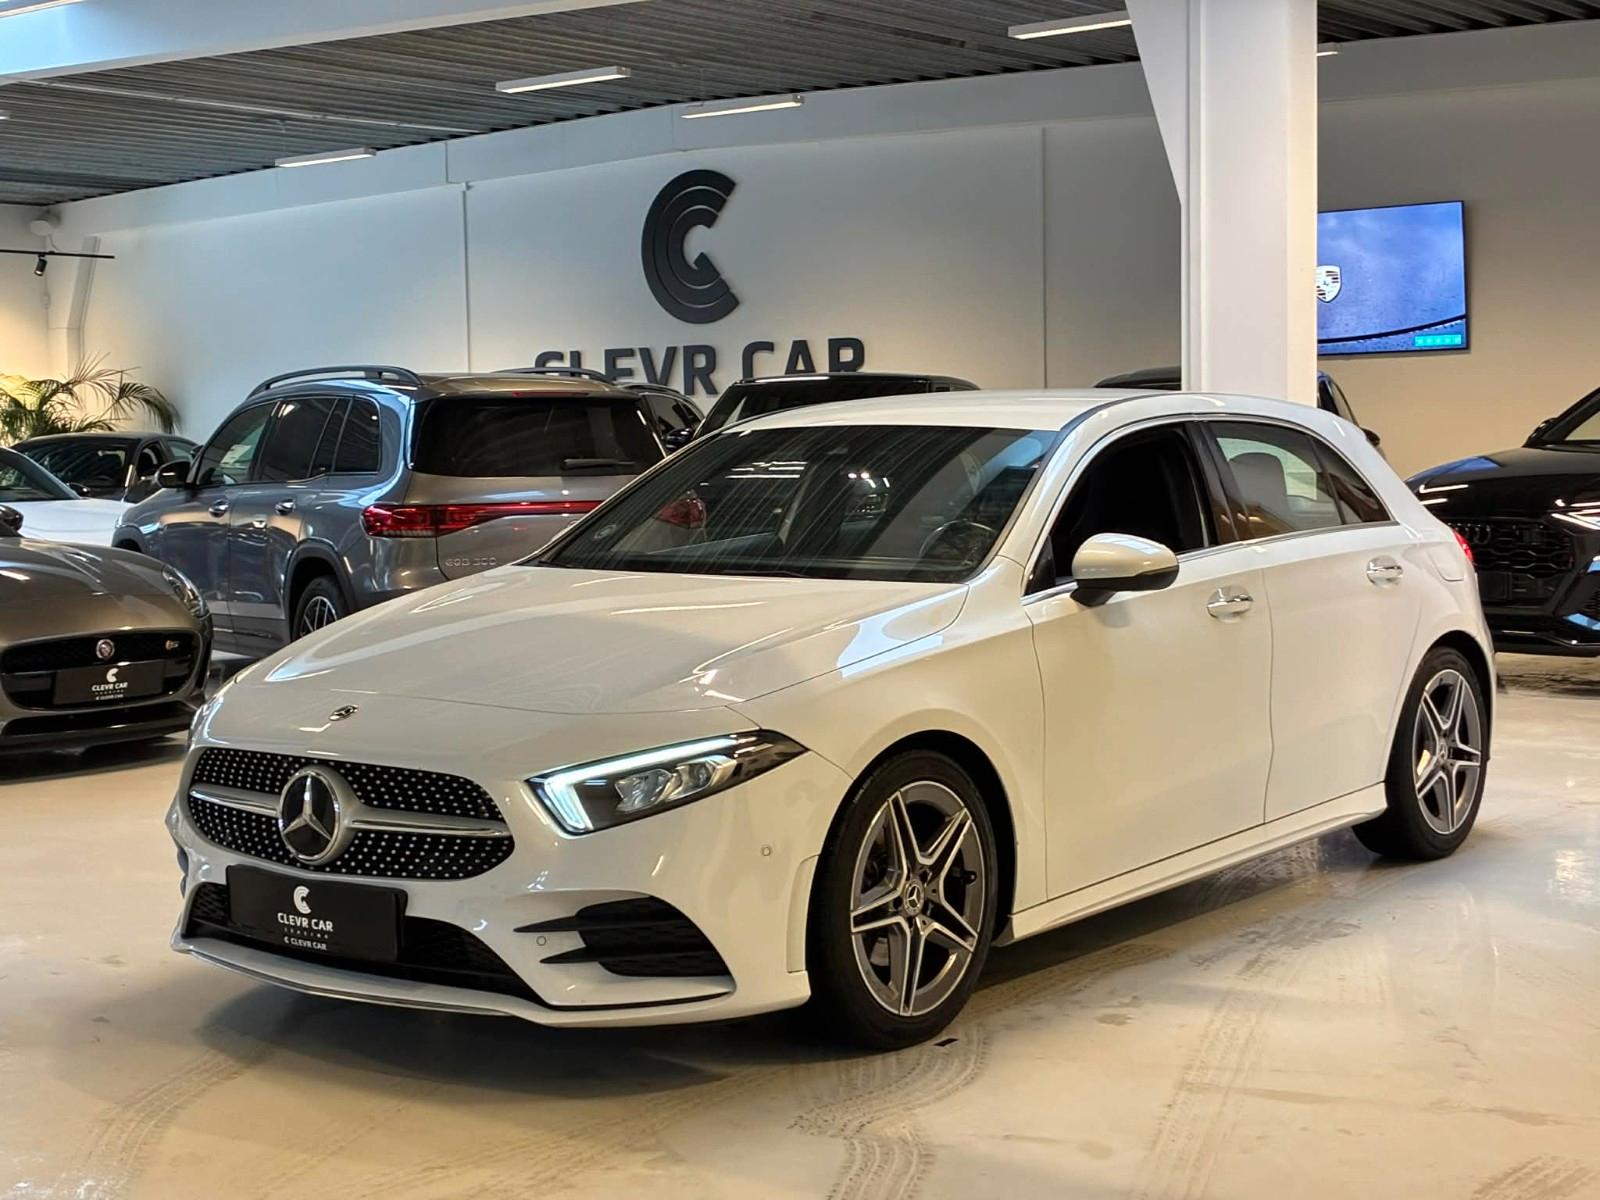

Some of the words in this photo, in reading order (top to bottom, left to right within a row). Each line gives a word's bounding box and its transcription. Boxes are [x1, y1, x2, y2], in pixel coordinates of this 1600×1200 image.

[742, 337, 865, 382] CAR
[277, 912, 309, 929] CLEVR
[311, 918, 334, 932] CAR
